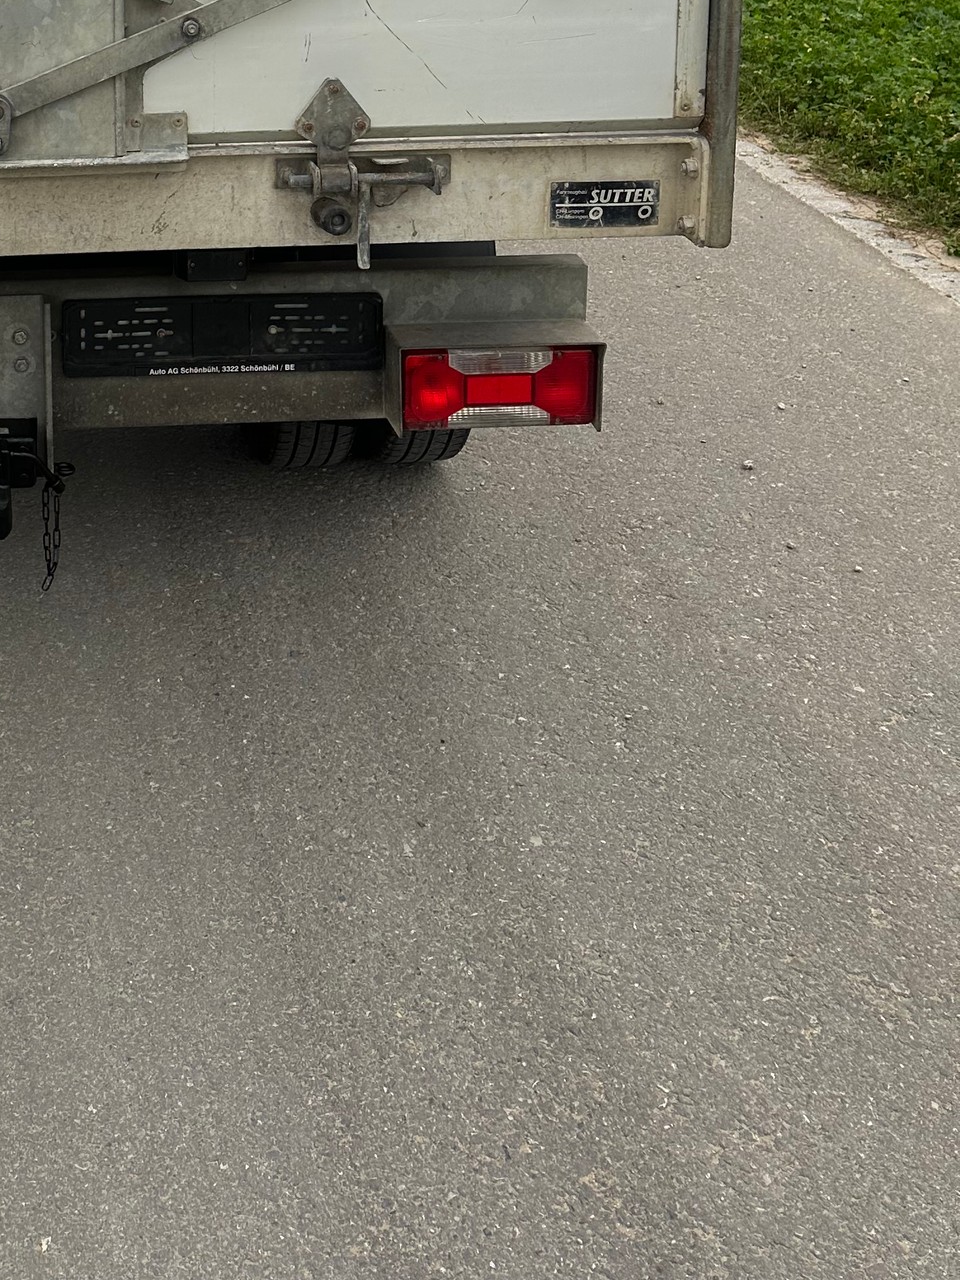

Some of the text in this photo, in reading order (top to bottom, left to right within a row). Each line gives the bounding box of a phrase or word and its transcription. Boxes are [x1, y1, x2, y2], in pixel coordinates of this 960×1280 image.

[589, 188, 655, 204] SUTTER
[149, 368, 166, 376] Auto
[167, 367, 179, 375] AG
[180, 365, 221, 374] Schönbühl,
[221, 365, 239, 373] 3322
[240, 364, 279, 372] Schönbühl
[284, 363, 296, 371] BE
